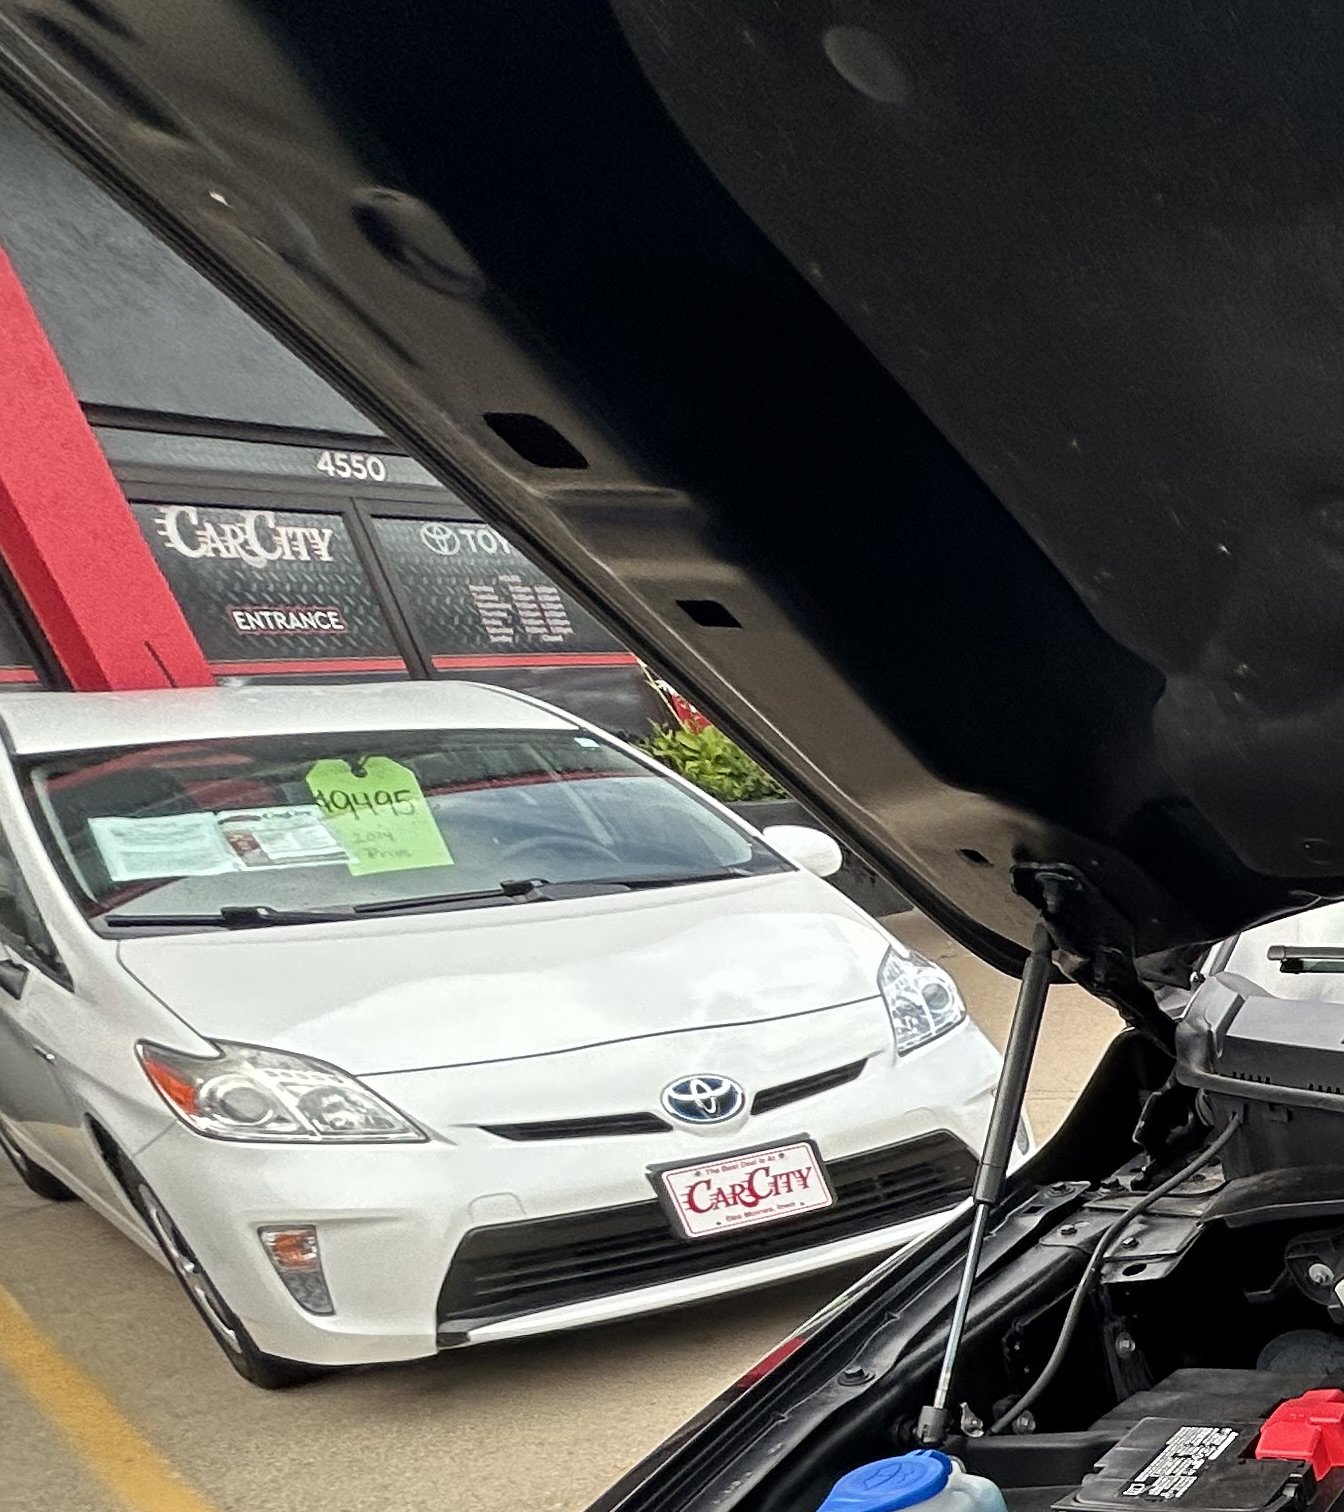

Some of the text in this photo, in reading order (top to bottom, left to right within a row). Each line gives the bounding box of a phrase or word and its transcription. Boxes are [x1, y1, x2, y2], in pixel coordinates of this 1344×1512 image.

[317, 451, 387, 482] 4550
[232, 610, 345, 630] ENTRANCE
[705, 1167, 720, 1176] The
[721, 1163, 740, 1173] Best
[741, 1160, 758, 1169] Deal
